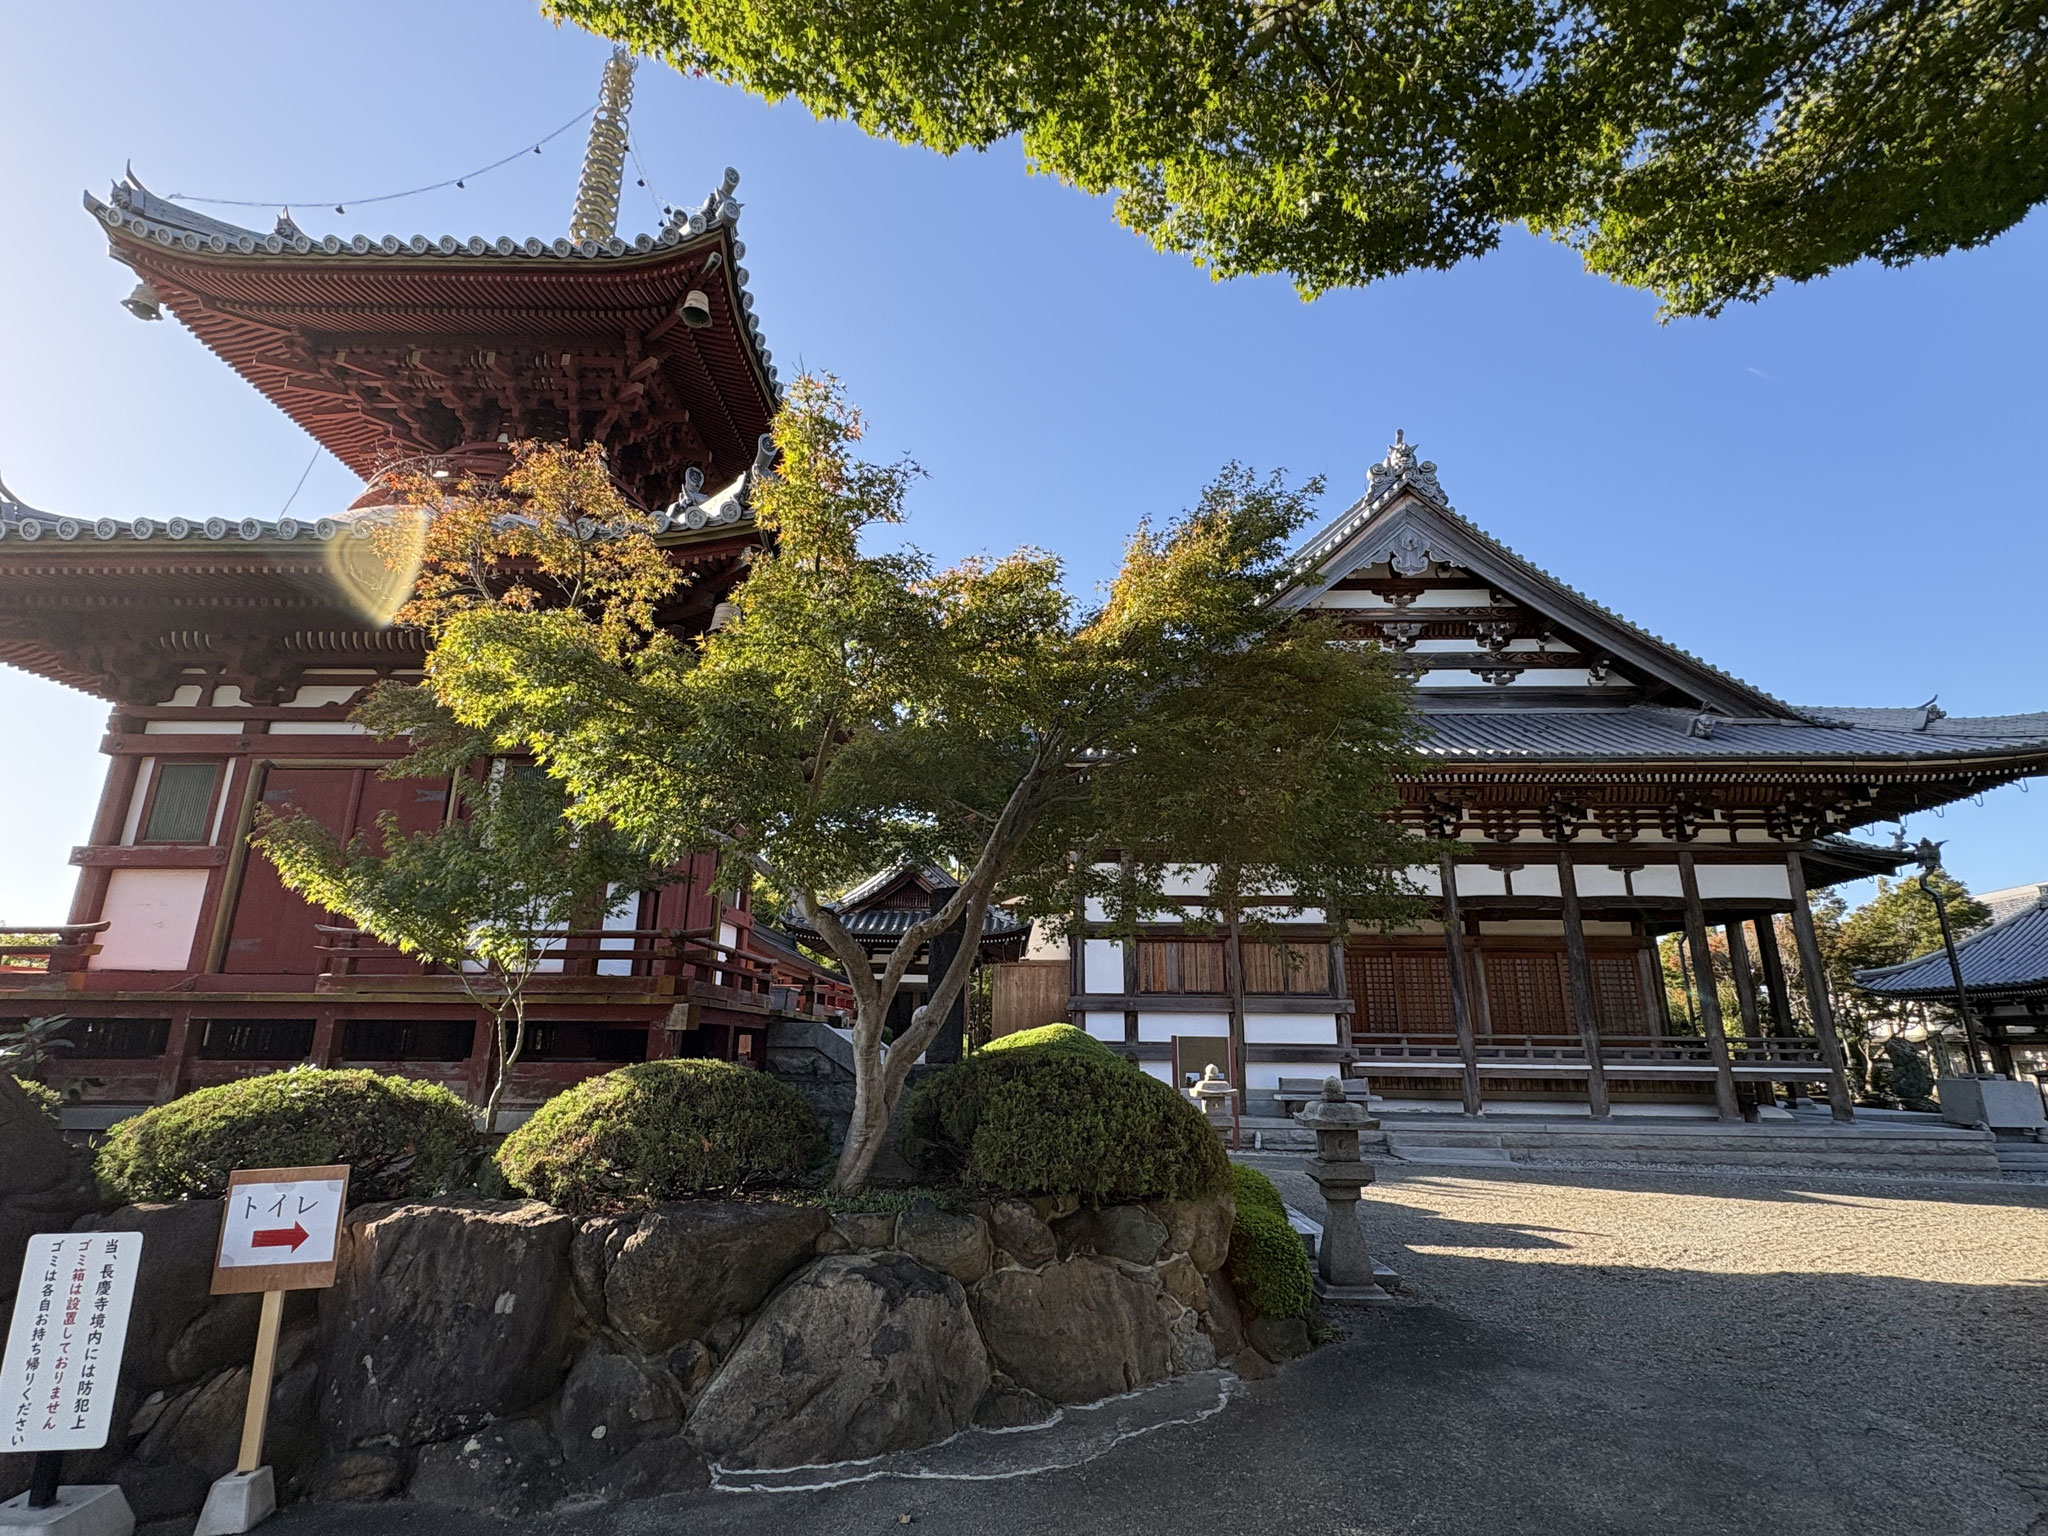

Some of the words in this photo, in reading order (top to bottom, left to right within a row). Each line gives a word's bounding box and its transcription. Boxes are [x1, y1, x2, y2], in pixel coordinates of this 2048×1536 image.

[245, 1193, 319, 1219] トイレ
[12, 1240, 65, 1446] ゴミは各自お持ち帰りください
[42, 1239, 92, 1430] ゴミ箱は設置しておりません
[70, 1239, 119, 1430] 当、長慶寺境内には防犯上
